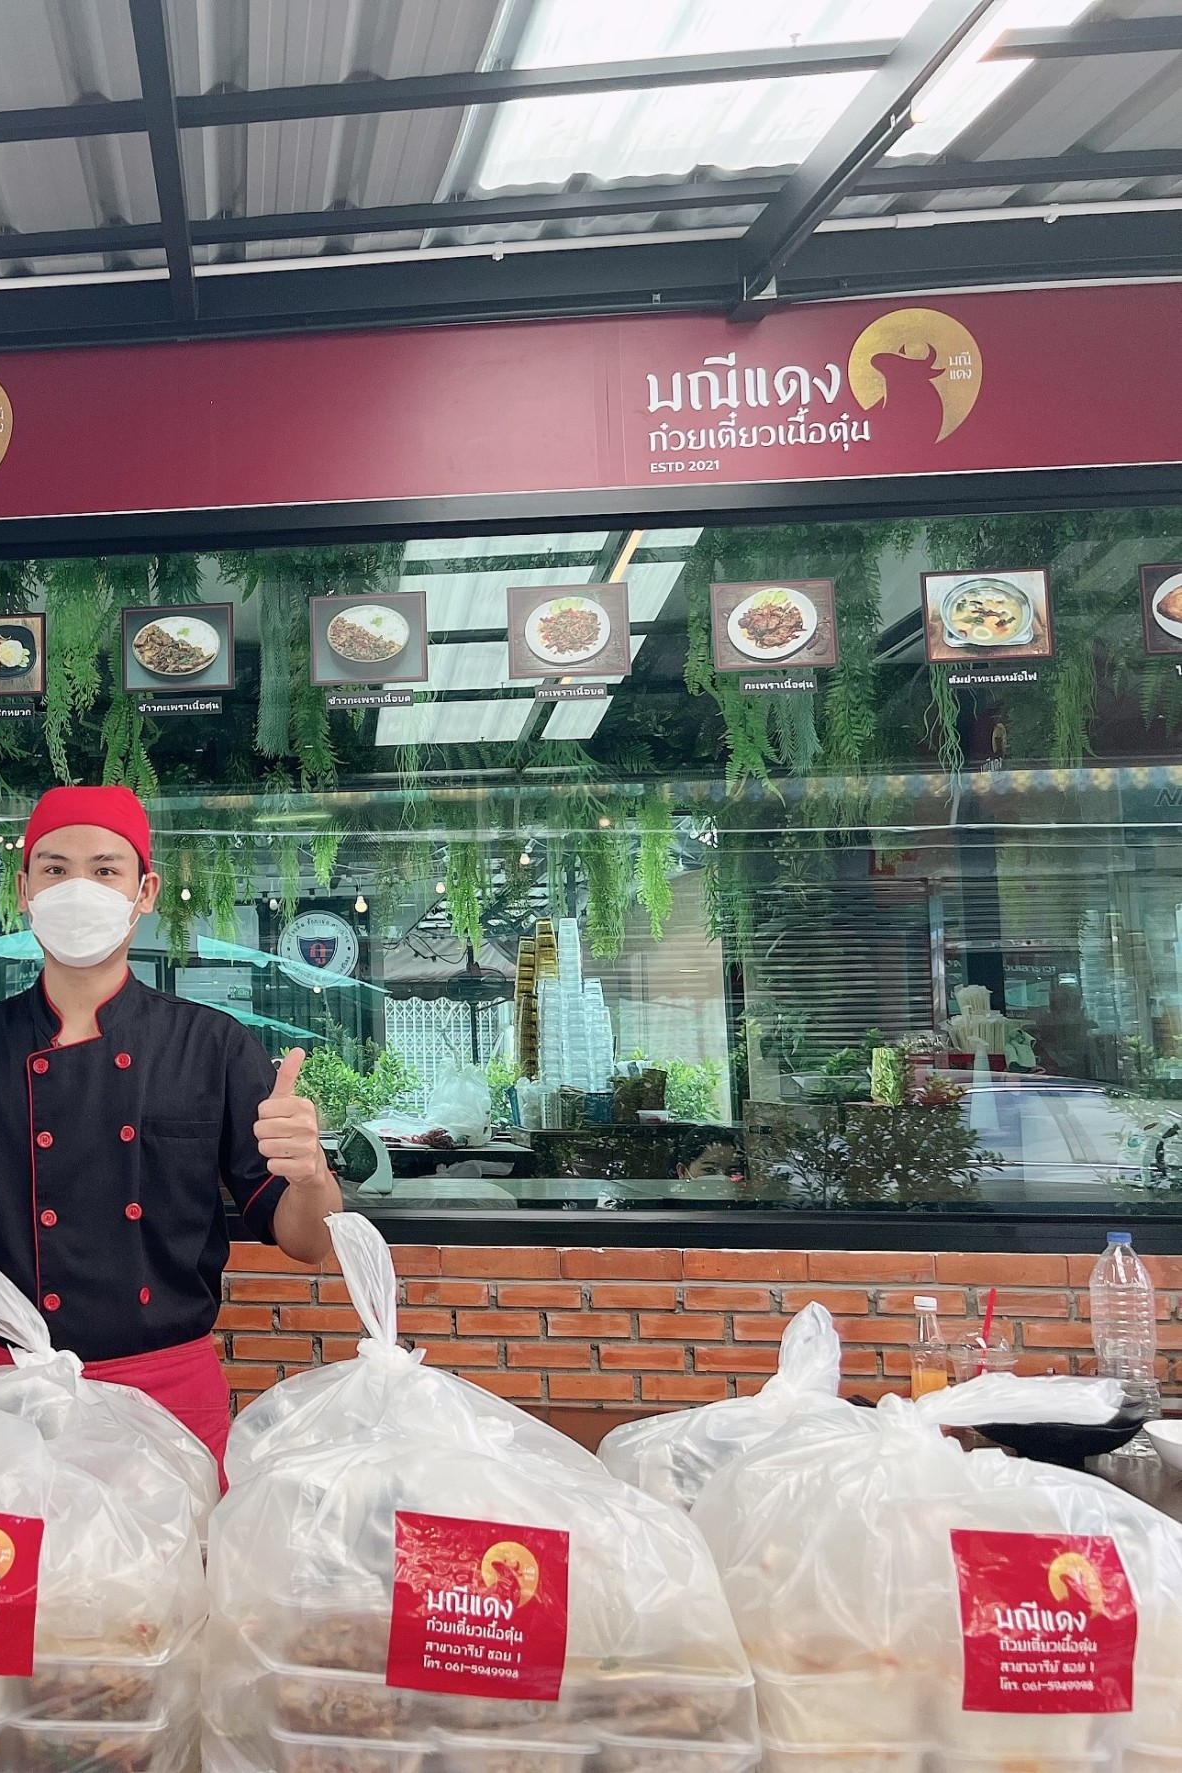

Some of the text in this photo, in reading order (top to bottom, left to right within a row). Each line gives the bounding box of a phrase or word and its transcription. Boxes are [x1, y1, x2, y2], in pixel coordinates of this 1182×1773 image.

[949, 352, 972, 368] มณี
[949, 367, 972, 382] แดง
[646, 352, 841, 414] มณีแดง
[648, 405, 871, 452] ก๋วยเตี๋ยวเนื้อตุ๋น
[650, 459, 720, 474] ESTD 2021
[427, 1586, 513, 1621] มณีแดง
[995, 1601, 1087, 1632] มณีแดง
[426, 1617, 523, 1647] ก๋วยเตี๋ยวเนื้อตุ๋น
[444, 1662, 519, 1679] 061-5949998
